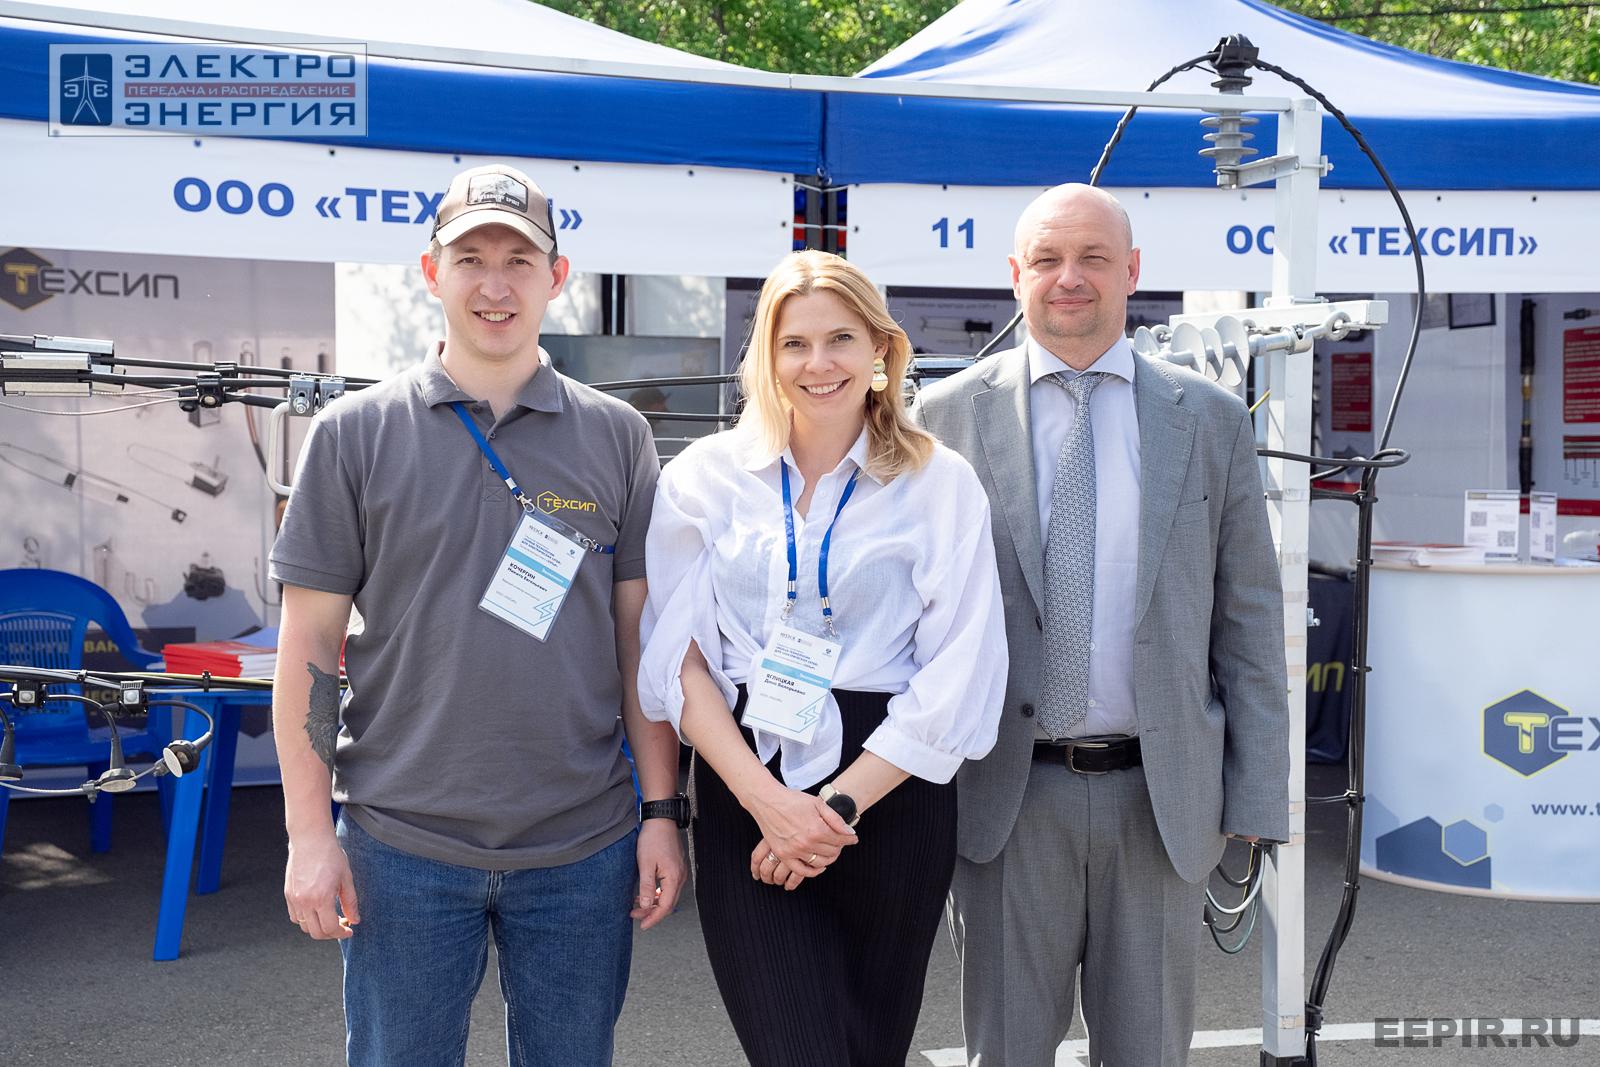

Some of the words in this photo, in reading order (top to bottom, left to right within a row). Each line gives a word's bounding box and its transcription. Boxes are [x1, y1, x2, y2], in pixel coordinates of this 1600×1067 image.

[173, 176, 295, 218] ООО
[932, 217, 974, 249] 11
[1226, 224, 1275, 255] ОО
[1328, 226, 1538, 257] «ТЕХСИП»
[4, 263, 180, 300] ТЕХСИП
[543, 497, 597, 513] ТЕХСИП
